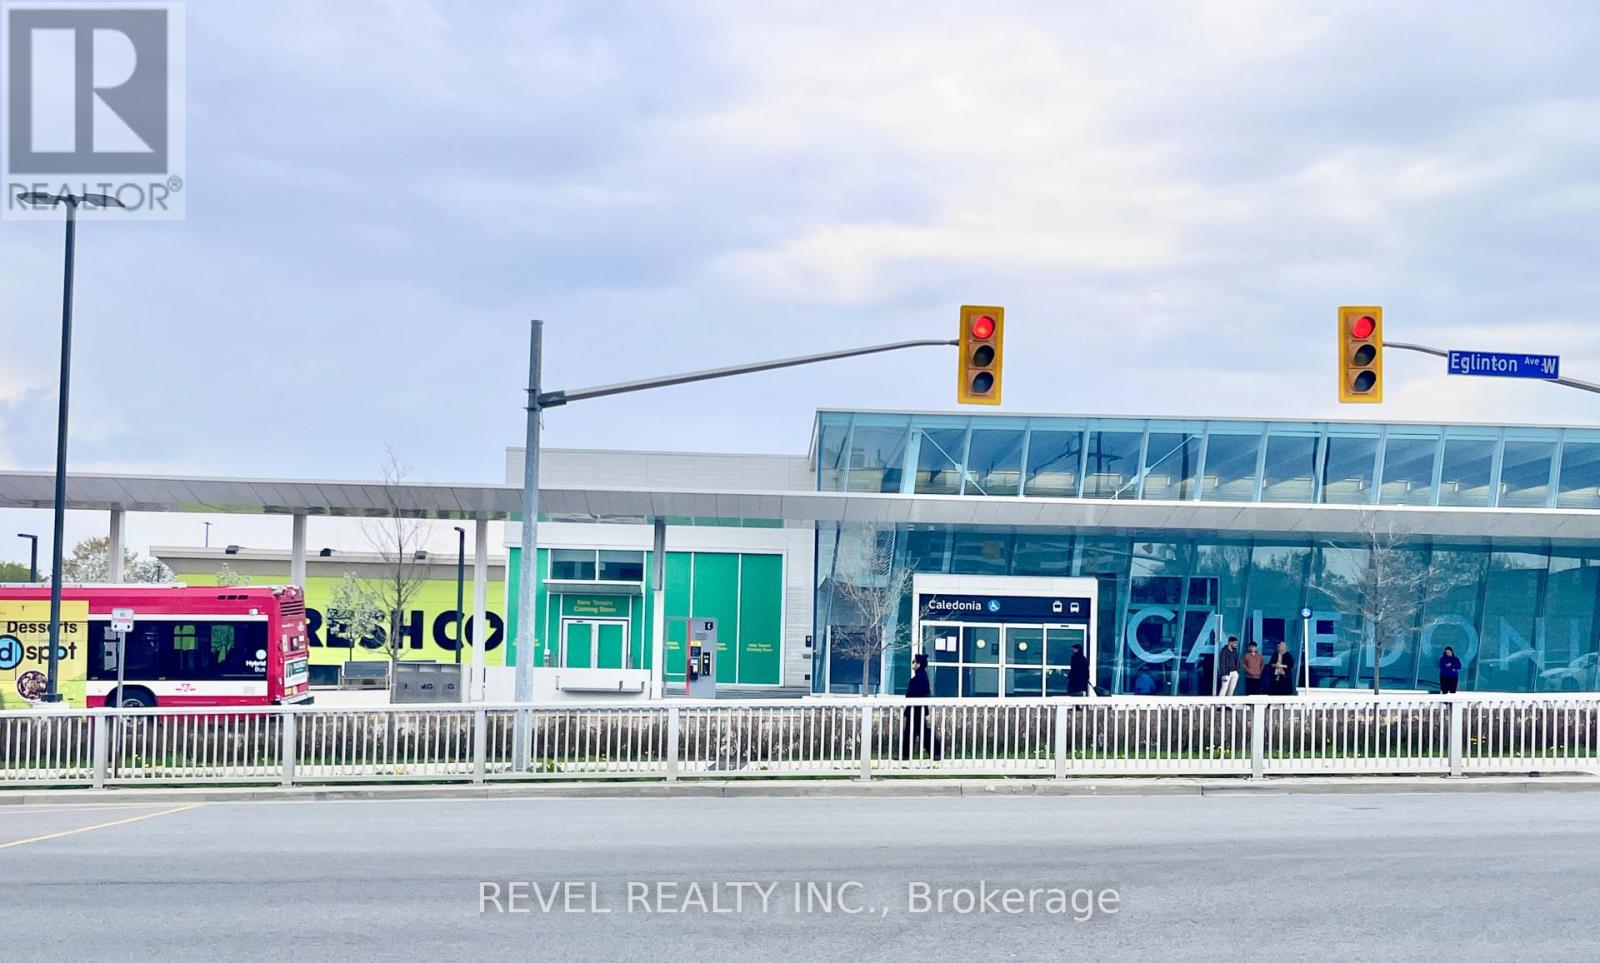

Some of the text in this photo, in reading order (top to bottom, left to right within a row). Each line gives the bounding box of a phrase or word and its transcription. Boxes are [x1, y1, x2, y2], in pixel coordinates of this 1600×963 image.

[1450, 352, 1556, 374] Eglinton Ave W
[928, 599, 982, 611] Caledonia
[26, 642, 77, 664] spot
[245, 660, 267, 668] Hybrid
